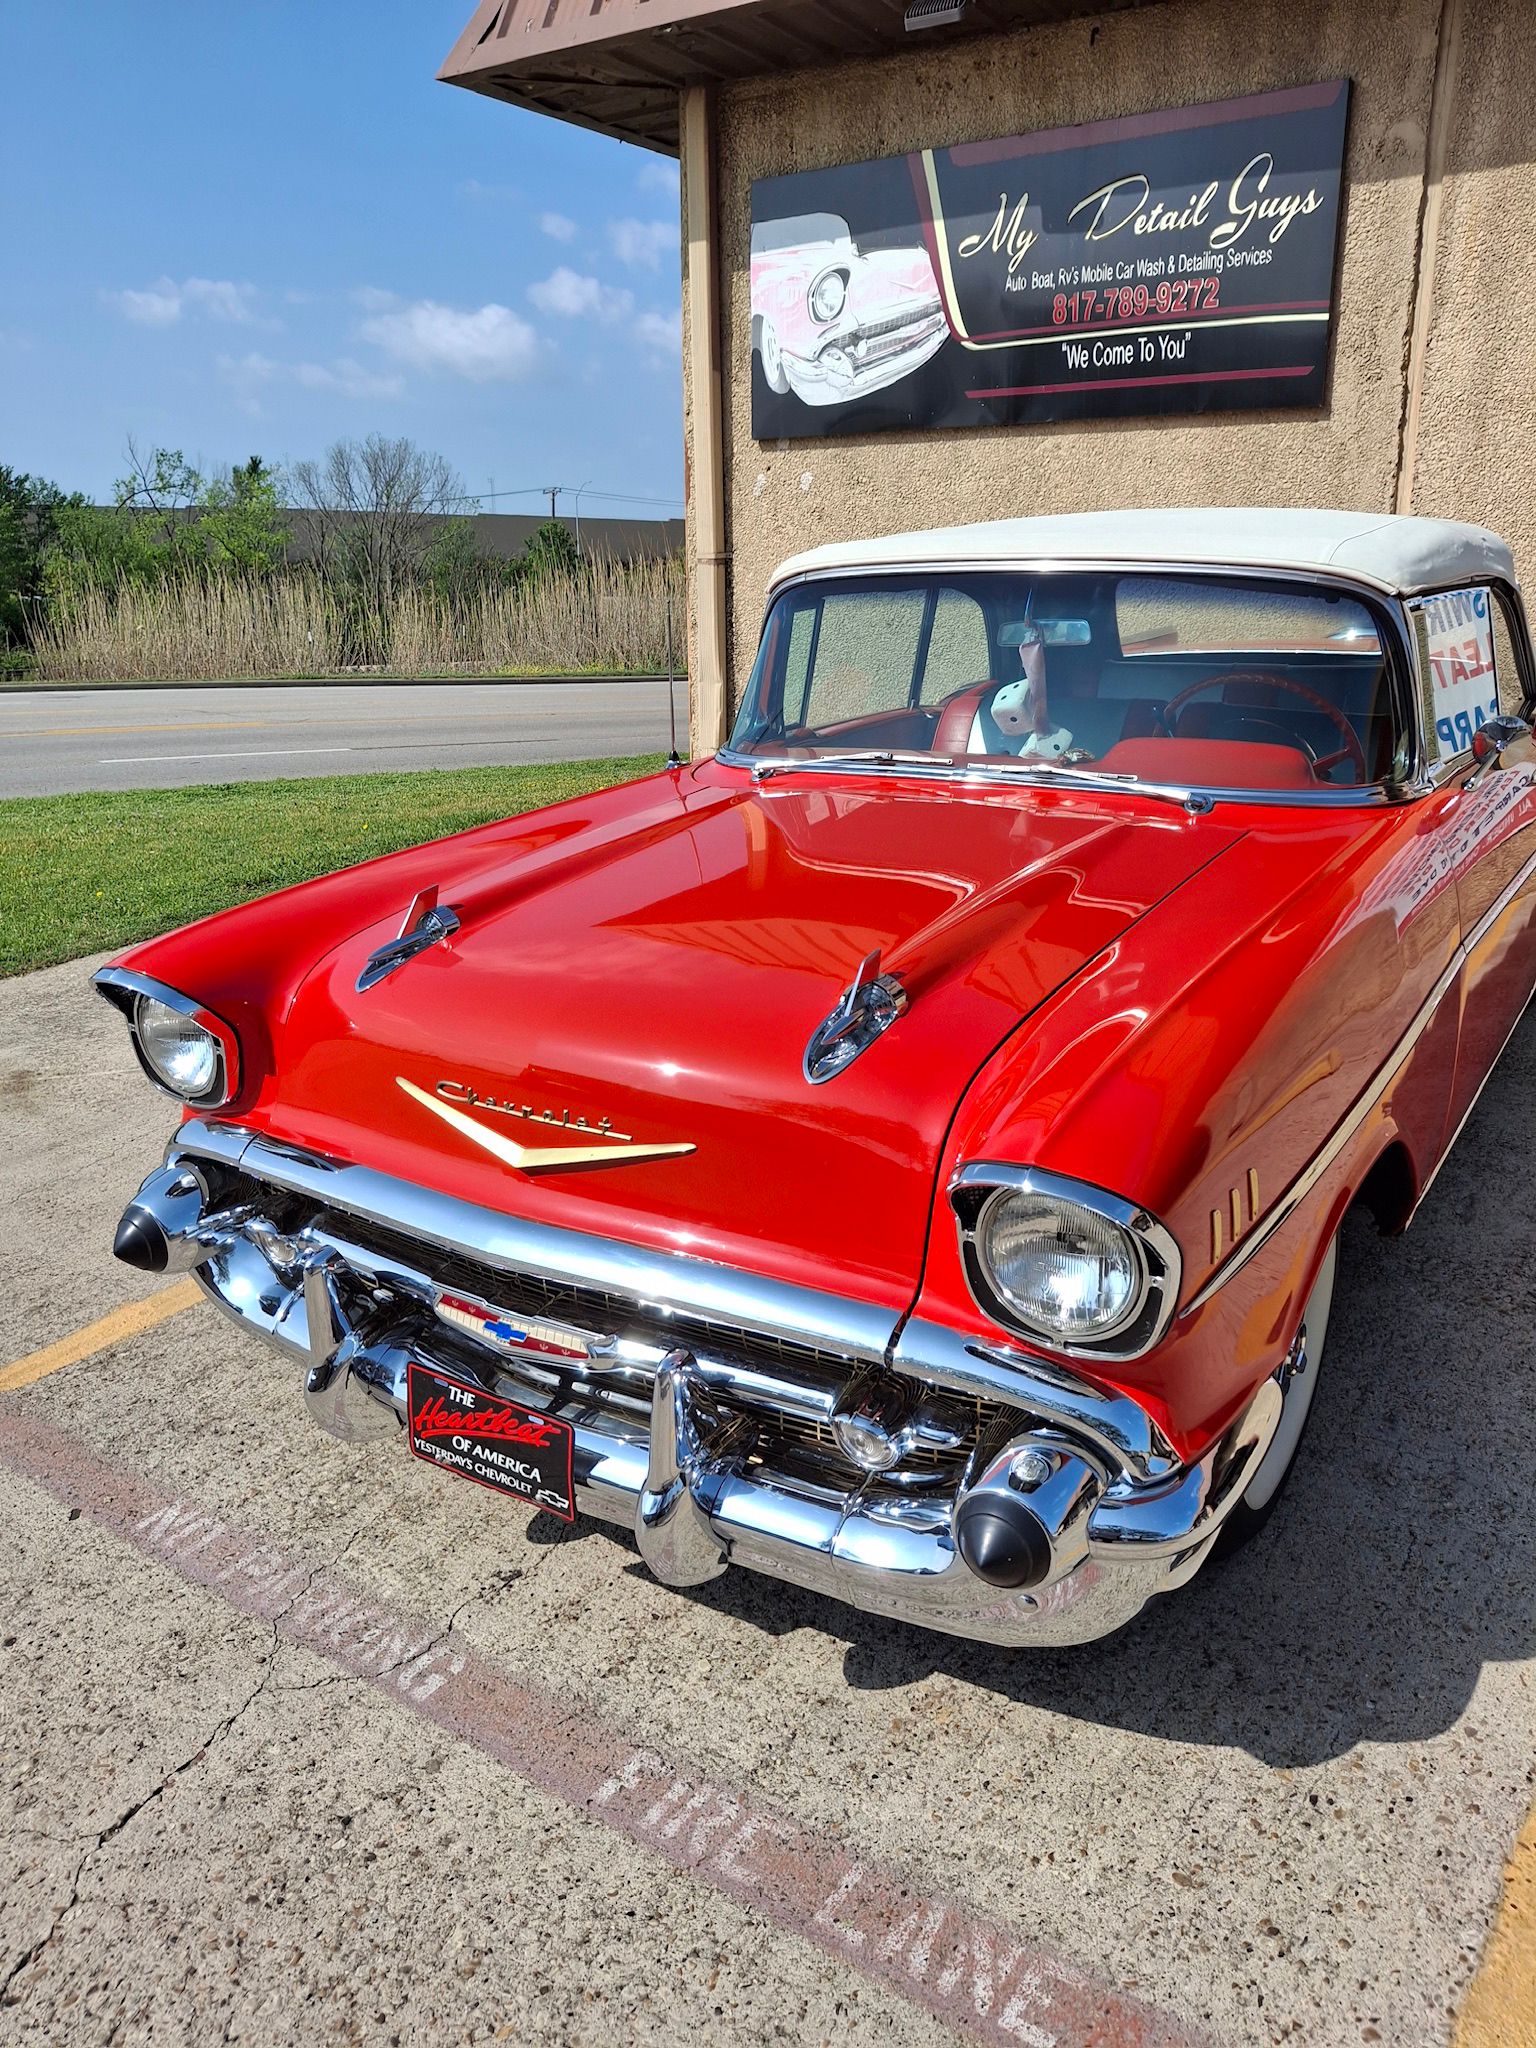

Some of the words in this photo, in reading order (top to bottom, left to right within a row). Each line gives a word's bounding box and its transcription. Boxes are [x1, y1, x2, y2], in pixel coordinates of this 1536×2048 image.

[958, 192, 1039, 273] My
[1067, 173, 1219, 241] Detail
[1210, 152, 1324, 249] Guys
[1005, 274, 1027, 292] Auto
[1032, 270, 1055, 290] Boat,
[1059, 266, 1079, 285] Rv's
[1081, 263, 1113, 283] Mobile
[1115, 261, 1134, 279] Car
[1136, 257, 1164, 278] Wash
[1167, 254, 1176, 274] &
[1178, 250, 1224, 273] Detailing
[1226, 246, 1273, 268] Services
[1052, 276, 1221, 325] 817-789-9272
[1062, 342, 1089, 369] "We
[1092, 341, 1134, 366] Come
[1138, 337, 1155, 362] To
[1158, 332, 1192, 360] You"
[436, 1080, 632, 1141] Chevrolet
[414, 1396, 561, 1447] Heartbeat
[449, 1385, 476, 1409] THE
[413, 1437, 473, 1471] YESTERDAY'S
[474, 1463, 533, 1494] CHEVROLET
[452, 1436, 473, 1453] OF
[472, 1445, 542, 1483] AMERICA
[594, 1748, 797, 1885] FIRE
[813, 1860, 1090, 2047] LANE
